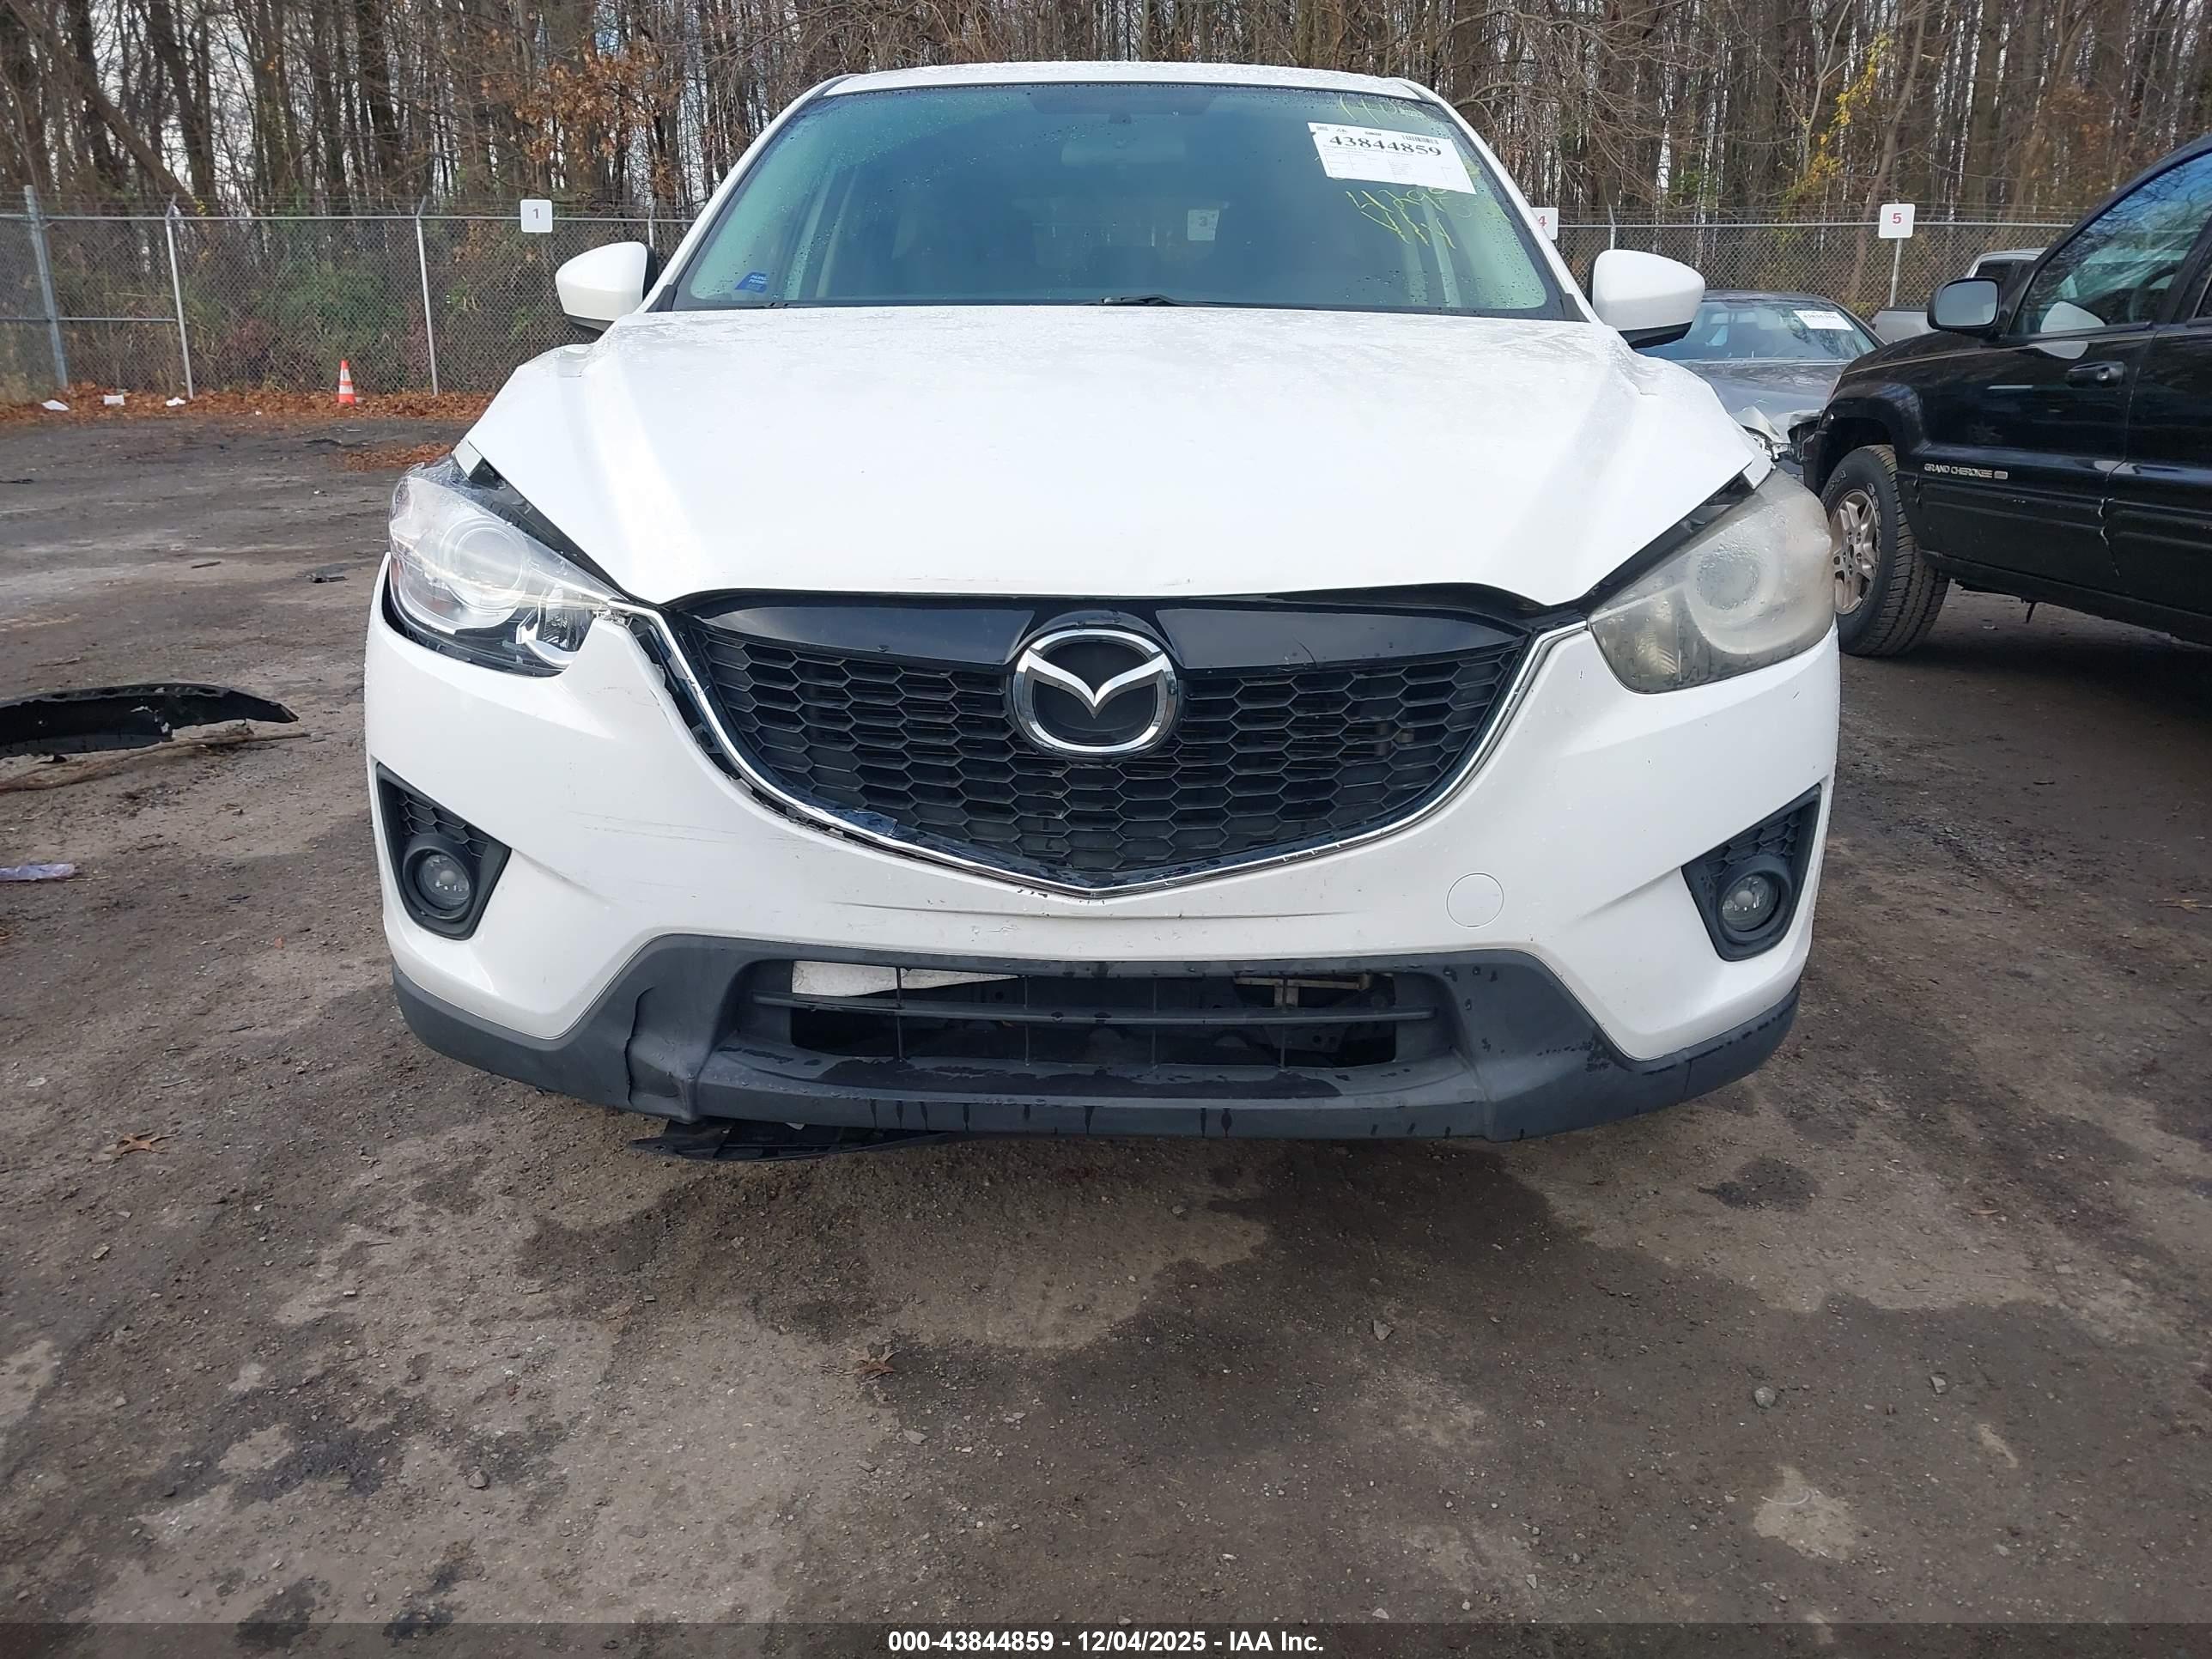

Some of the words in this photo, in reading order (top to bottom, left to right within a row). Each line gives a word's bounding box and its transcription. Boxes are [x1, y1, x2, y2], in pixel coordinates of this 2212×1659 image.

[1329, 136, 1442, 156] 43844859
[532, 208, 539, 220] 1
[1892, 212, 1902, 224] 5
[1538, 215, 1547, 228] 4
[1924, 464, 1950, 473] GRAND
[1950, 466, 1993, 478] CHEROKEE
